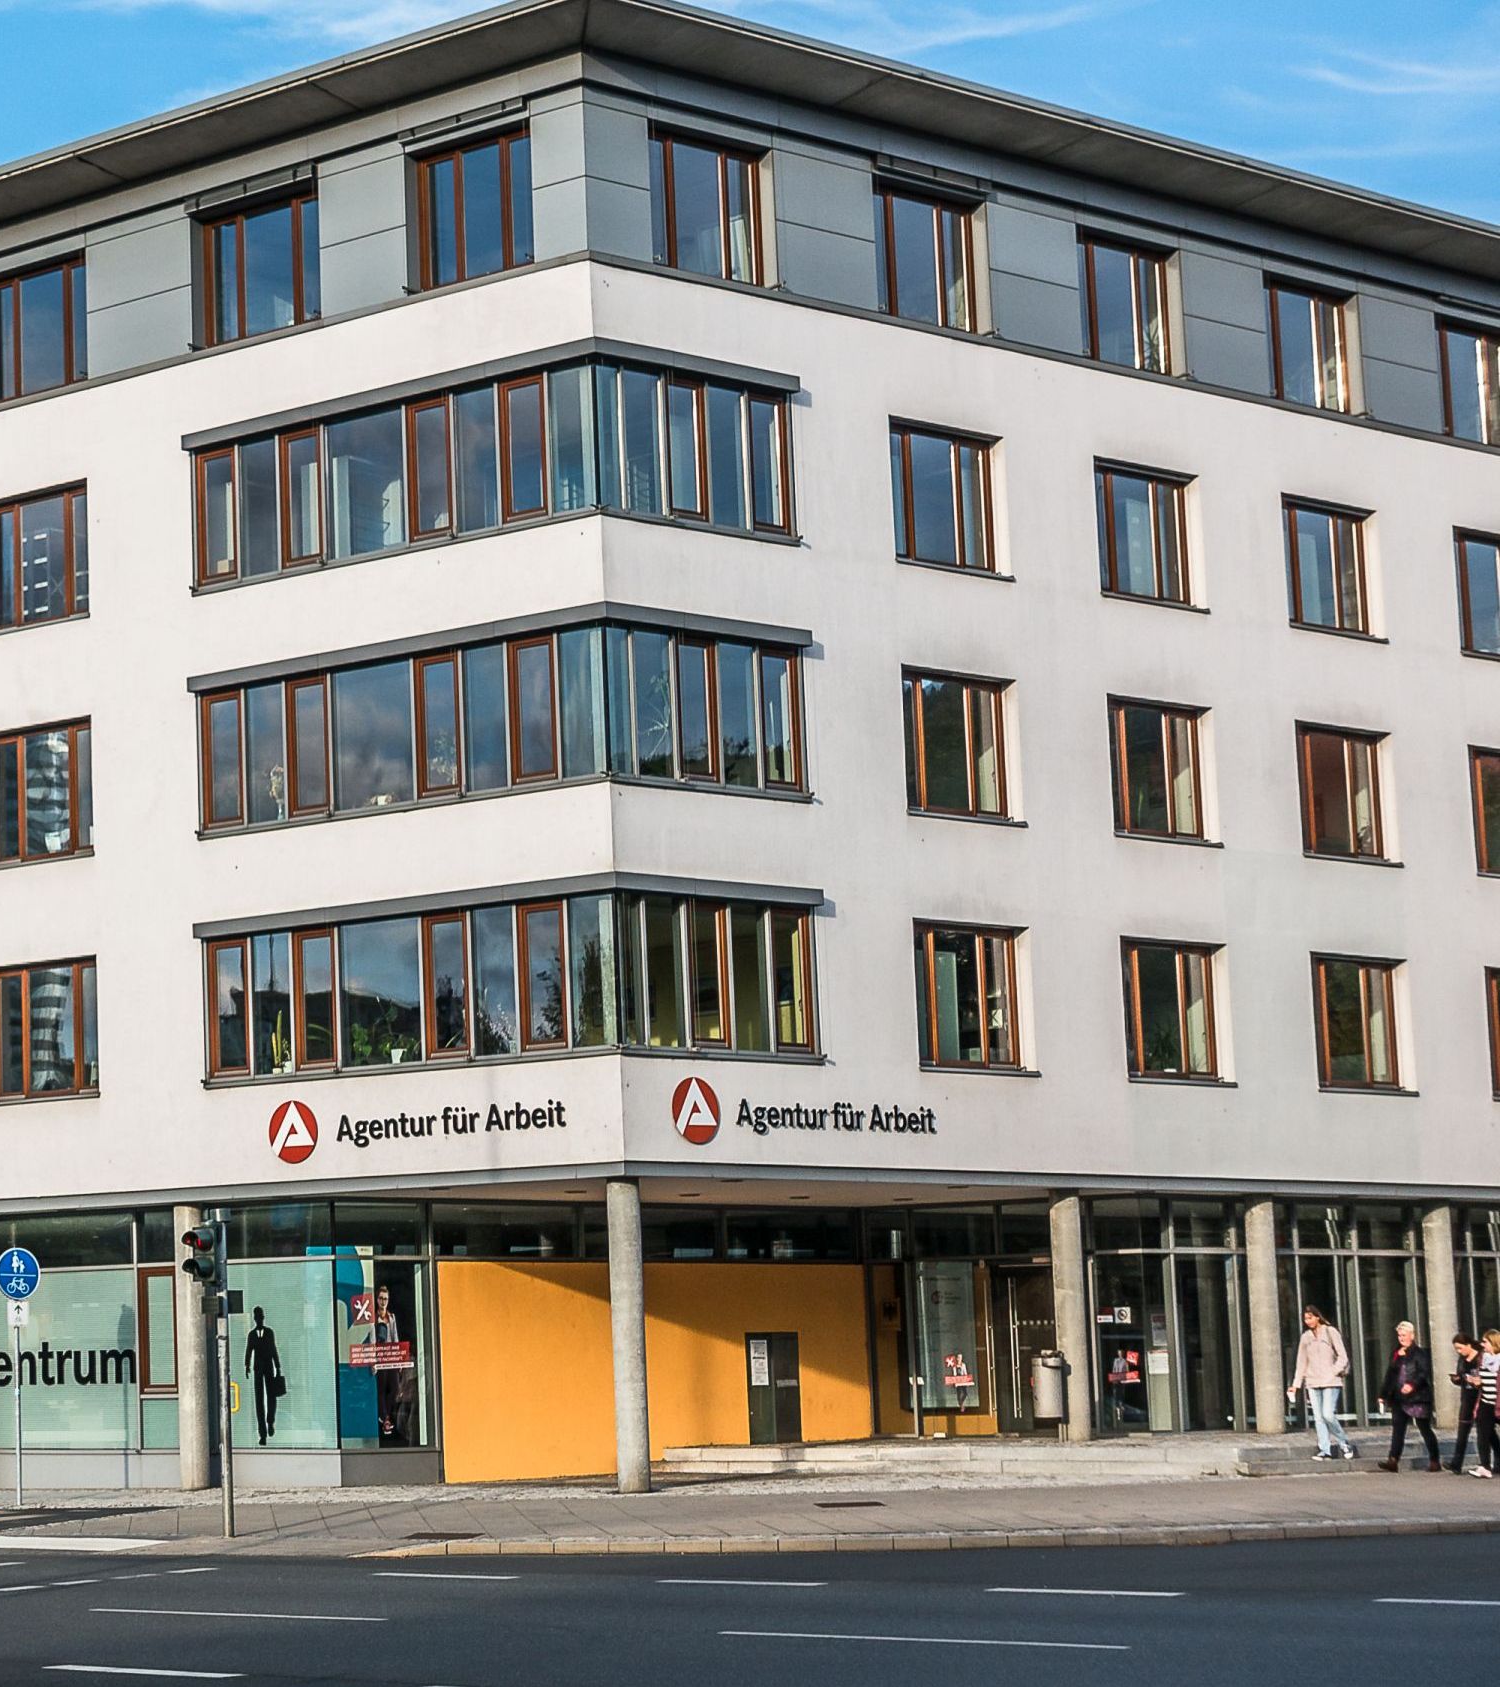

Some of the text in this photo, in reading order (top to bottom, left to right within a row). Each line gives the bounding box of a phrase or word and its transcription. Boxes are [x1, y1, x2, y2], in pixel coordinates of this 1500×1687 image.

[336, 1099, 567, 1148] Agentur für Arbeit
[735, 1098, 937, 1136] Agentur für Arbeit
